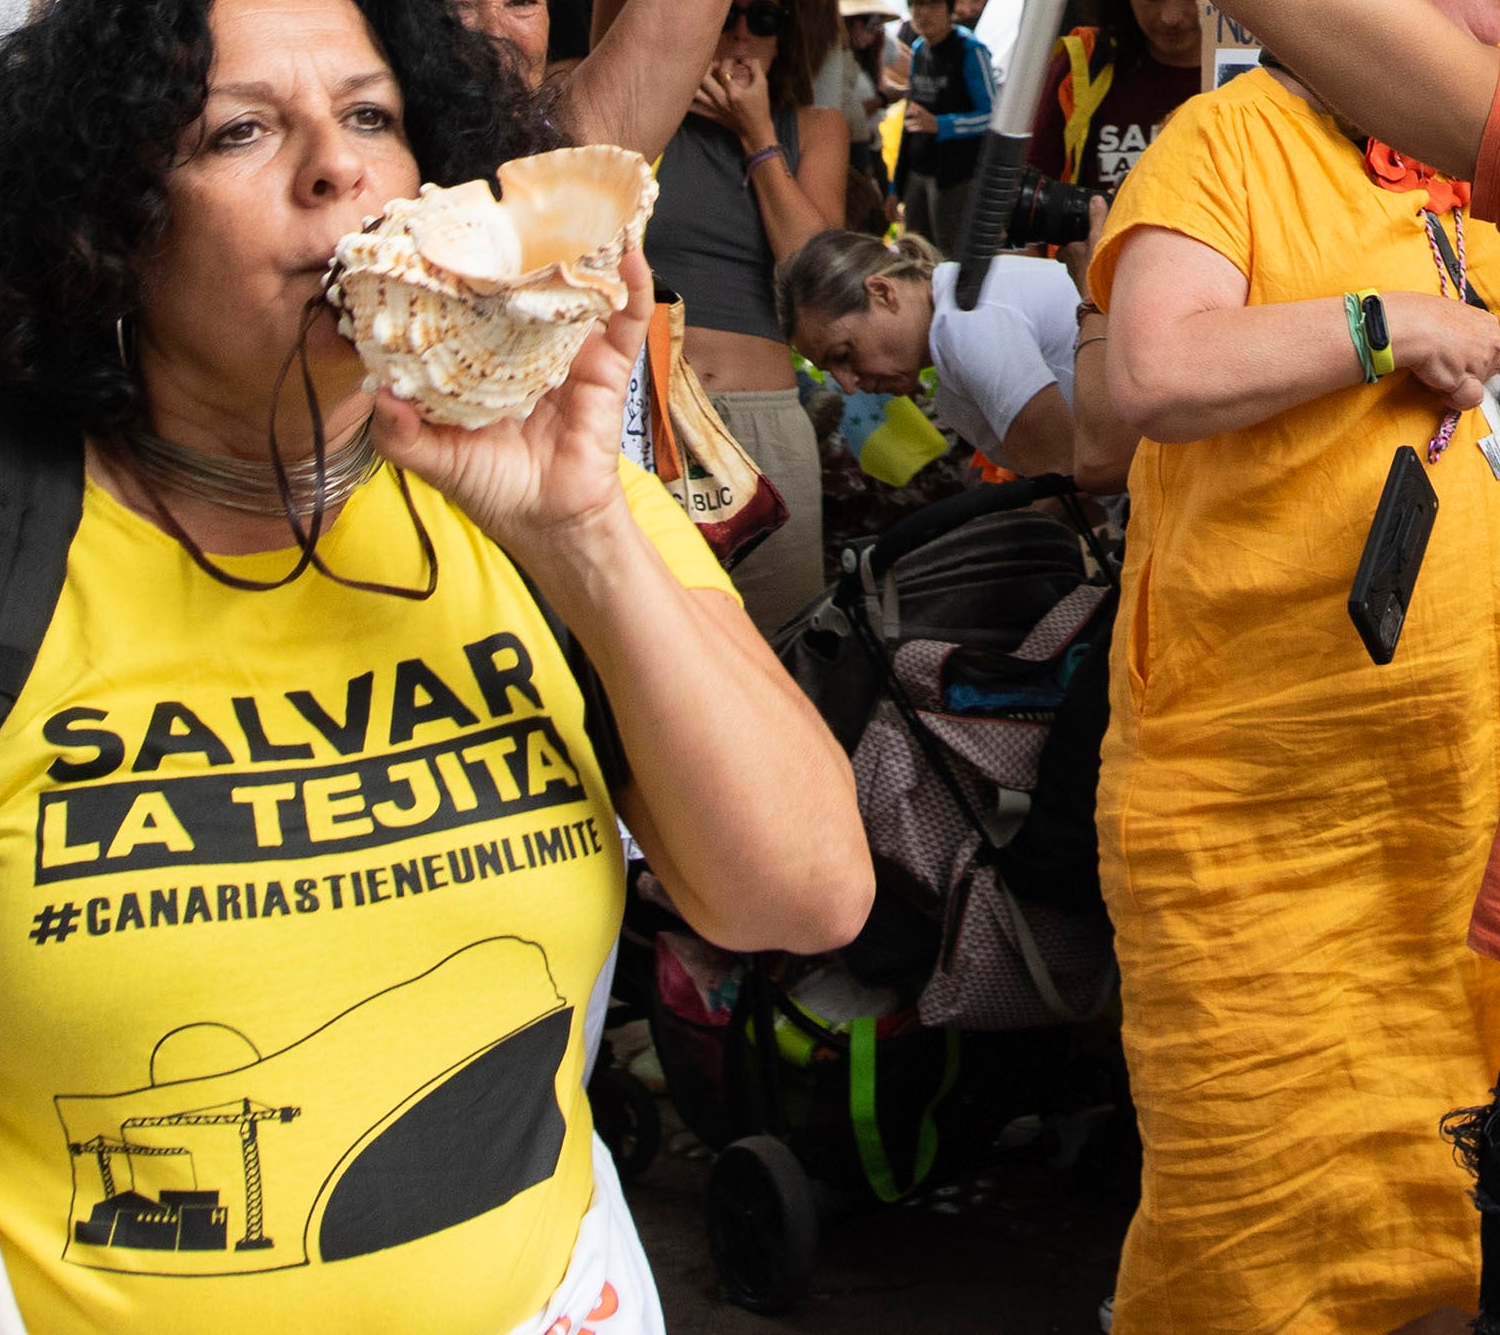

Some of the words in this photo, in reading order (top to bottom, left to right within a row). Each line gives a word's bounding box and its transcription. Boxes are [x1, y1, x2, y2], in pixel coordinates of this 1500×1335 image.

[41, 631, 544, 783] SALVAR
[41, 792, 195, 869] LA
[231, 730, 579, 847] TEJITA
[28, 817, 604, 946] #CANARIASTIENEUNLIMITE
